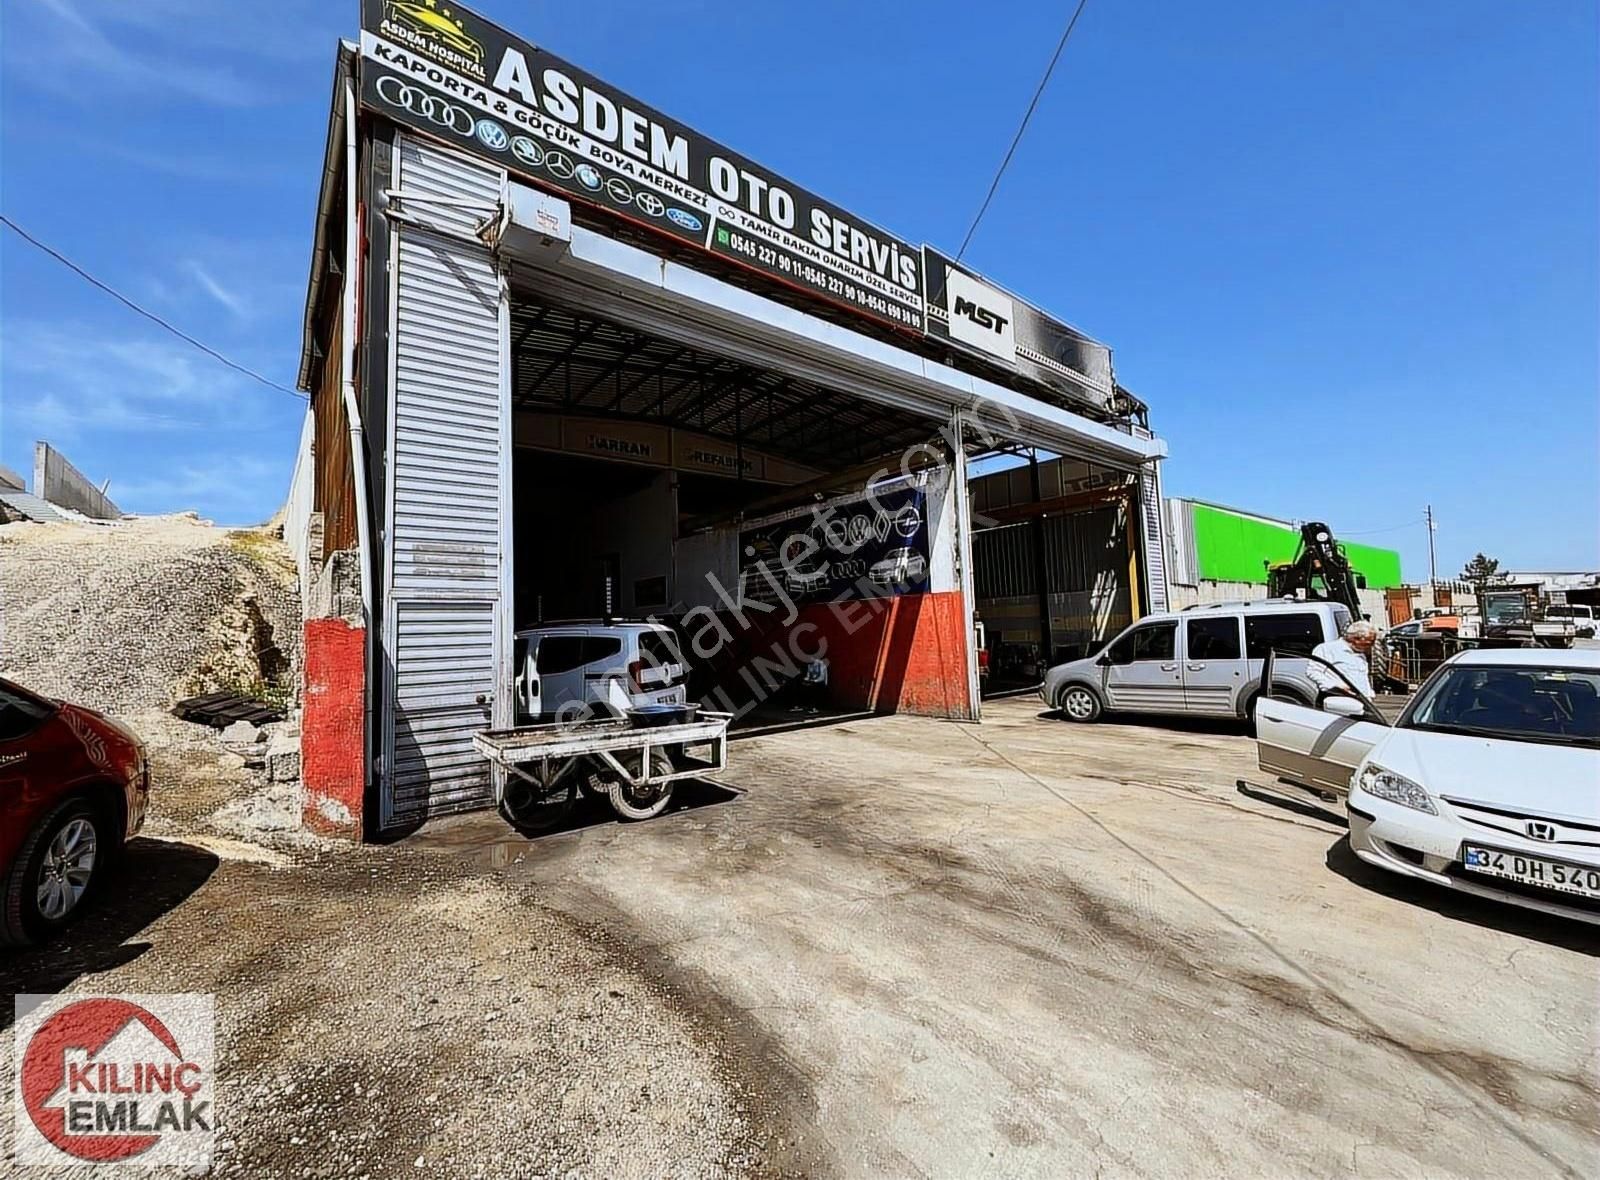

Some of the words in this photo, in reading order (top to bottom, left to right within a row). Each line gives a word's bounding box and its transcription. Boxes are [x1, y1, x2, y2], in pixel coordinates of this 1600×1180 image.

[380, 19, 426, 47] ASDEM
[429, 42, 486, 77] HOSPITAL
[374, 43, 488, 105] KAPORTA
[493, 100, 508, 115] &
[514, 109, 581, 148] GÖÇÜK
[590, 145, 634, 174] BOYA
[638, 170, 709, 207] MERKEZİ
[493, 46, 689, 181] ASDEM
[710, 156, 796, 229] OTO
[810, 206, 917, 290] SERVİS
[739, 215, 780, 241] TAMİR
[730, 233, 756, 257] 0545
[759, 245, 777, 266] 227
[778, 254, 791, 272] 90
[828, 275, 844, 295] 227
[954, 295, 1008, 335] MST
[1478, 849, 1505, 871] 34
[1513, 857, 1544, 881] DH
[1552, 864, 1600, 890] 540
